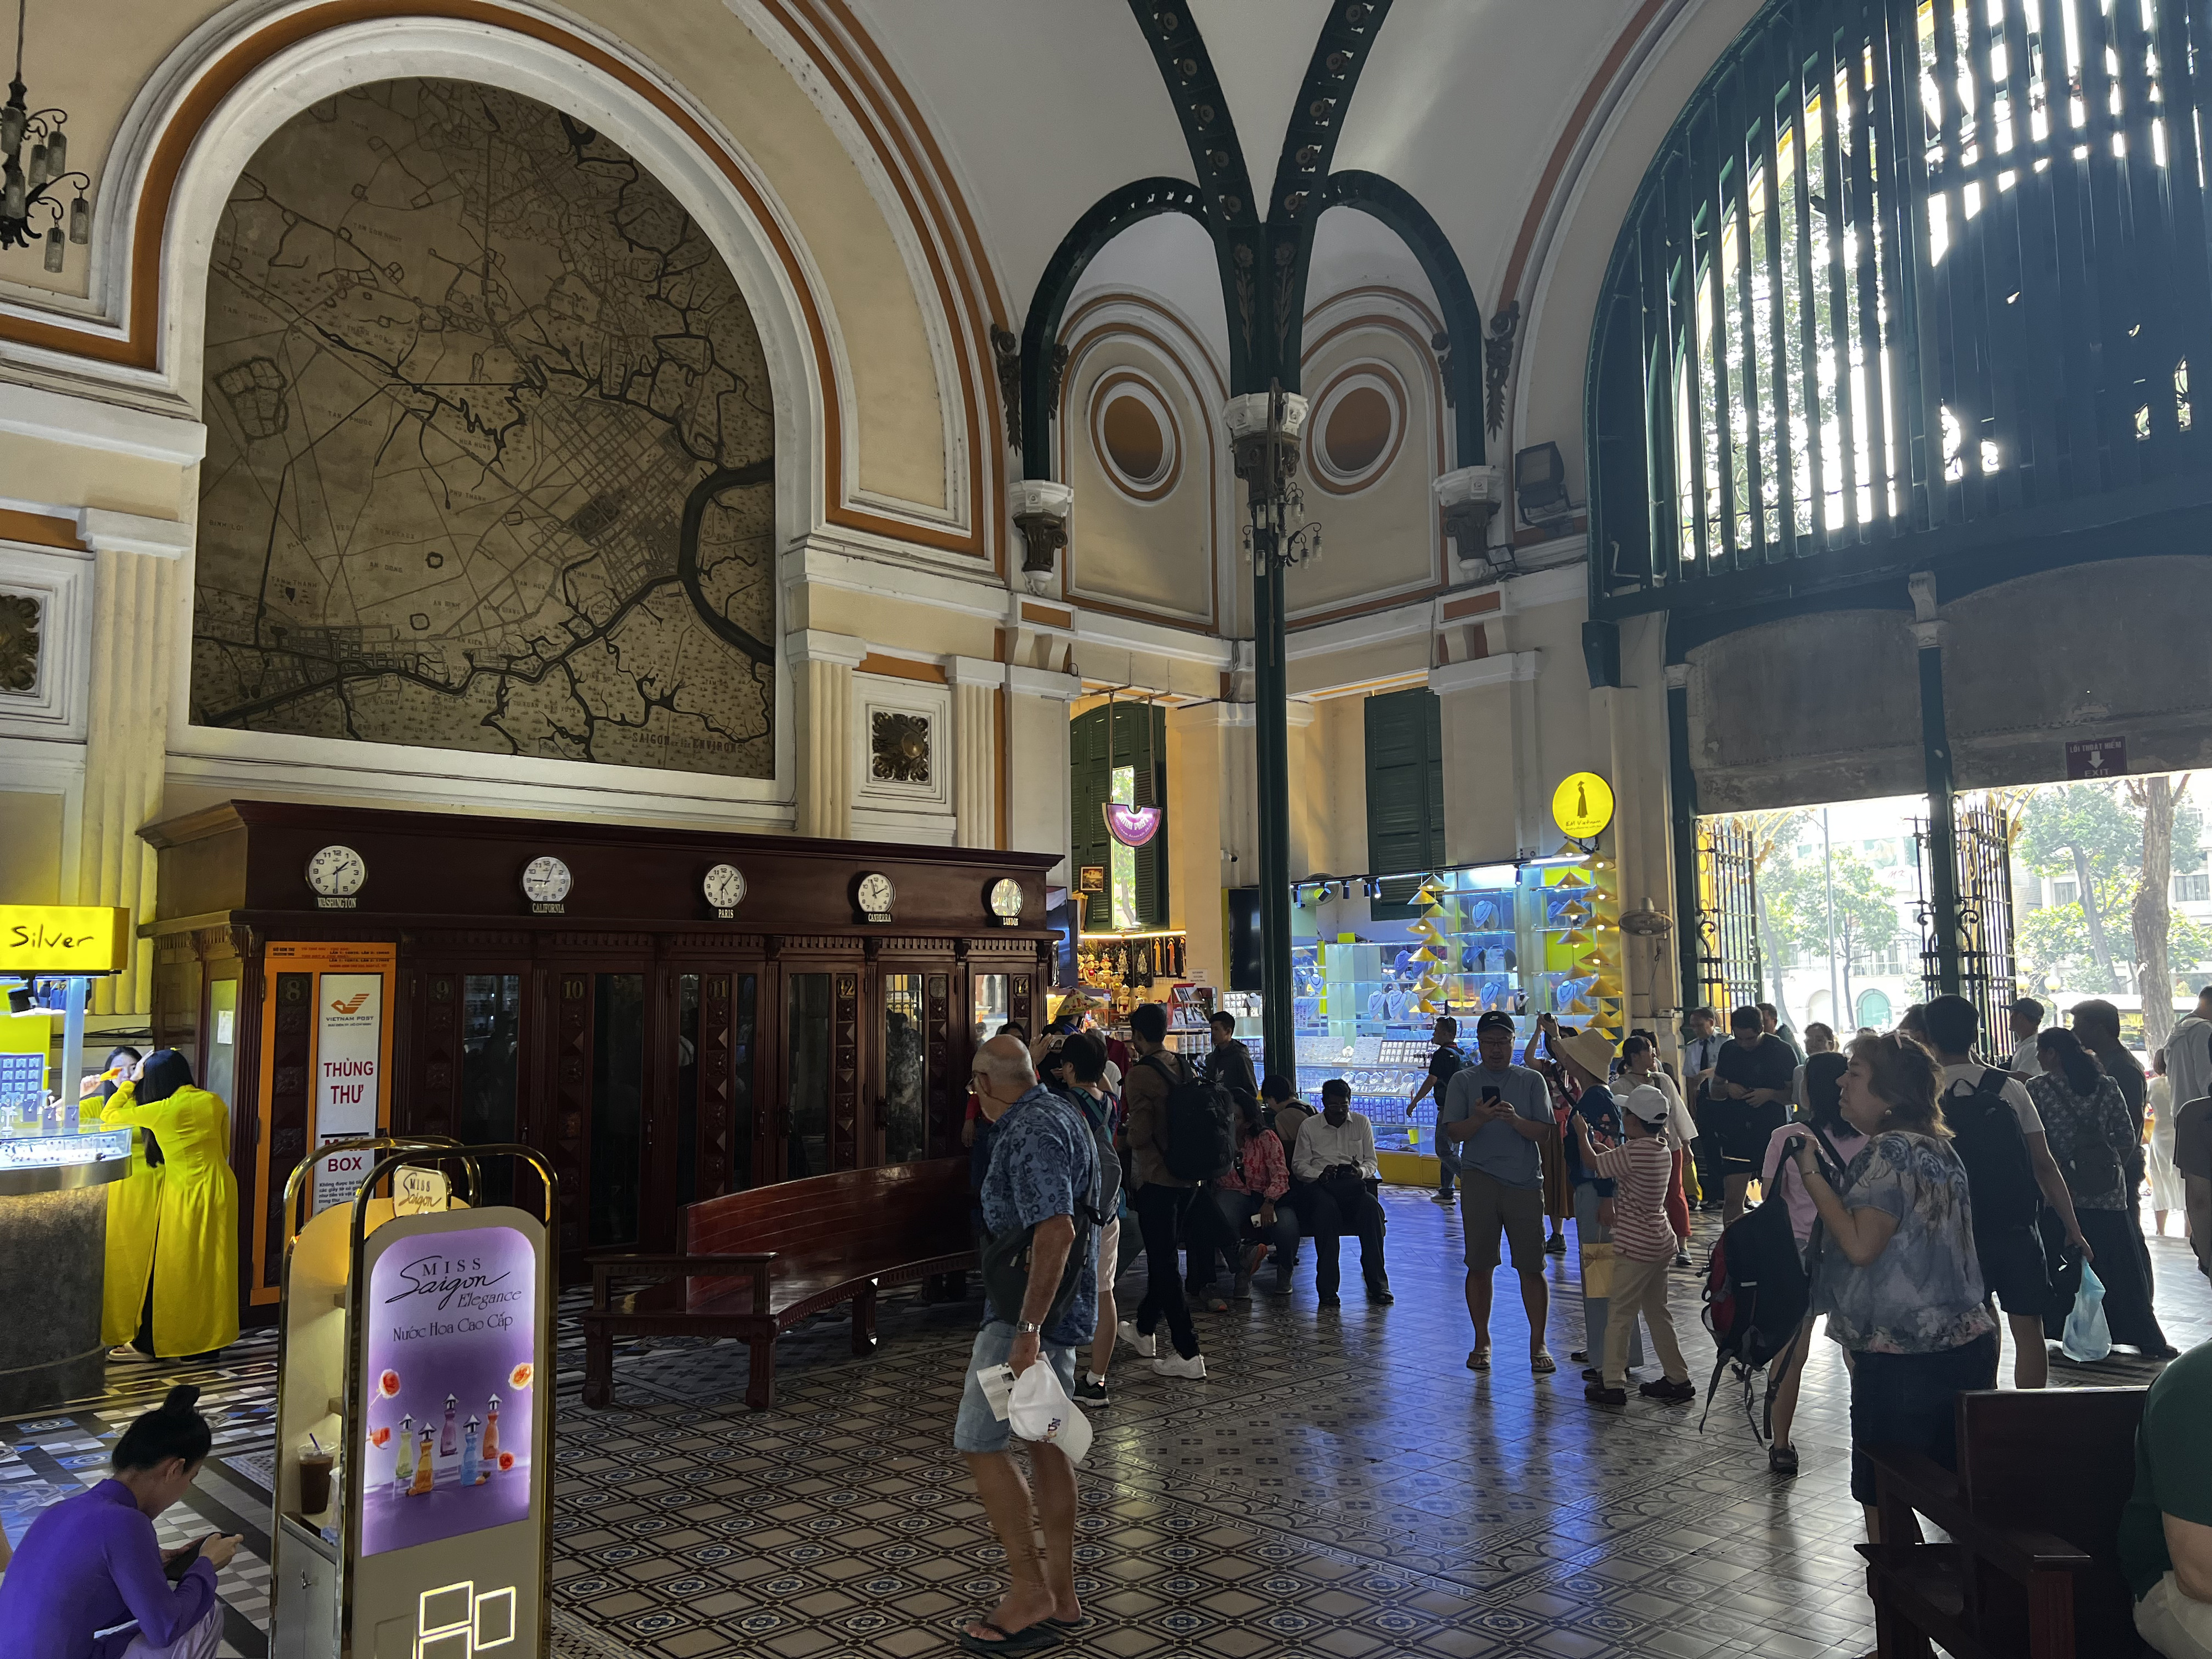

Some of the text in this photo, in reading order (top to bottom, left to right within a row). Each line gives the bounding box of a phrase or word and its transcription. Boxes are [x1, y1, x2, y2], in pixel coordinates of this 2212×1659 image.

[327, 410, 342, 419] TAN
[632, 732, 670, 745] SAIGON
[693, 739, 743, 753] ENVIRONS
[2070, 745, 2080, 753] LỐI
[2082, 743, 2103, 752] THOÁT
[2084, 768, 2110, 778] EXIT
[317, 897, 357, 908] WASHINGTON
[532, 903, 565, 913] CALIFORNIA
[718, 909, 734, 919] PARIS
[1003, 917, 1019, 926] LONDON
[9, 924, 95, 948] Silver
[285, 979, 301, 1001] 8
[436, 980, 449, 1000] 9
[563, 980, 583, 999] 10
[712, 979, 727, 998] 11
[840, 979, 854, 996] 12
[1016, 979, 1029, 994] 14
[324, 1058, 374, 1078] THÙNG
[330, 1084, 364, 1104] THƯ
[328, 1157, 362, 1172] BOX
[398, 1172, 442, 1214] Saigon
[410, 1178, 430, 1192] MISS
[422, 1258, 481, 1277] MISS
[385, 1255, 511, 1311] Saigon
[457, 1290, 522, 1311] Elegance
[393, 1312, 513, 1342] Nước Hoa Cao Cấp
